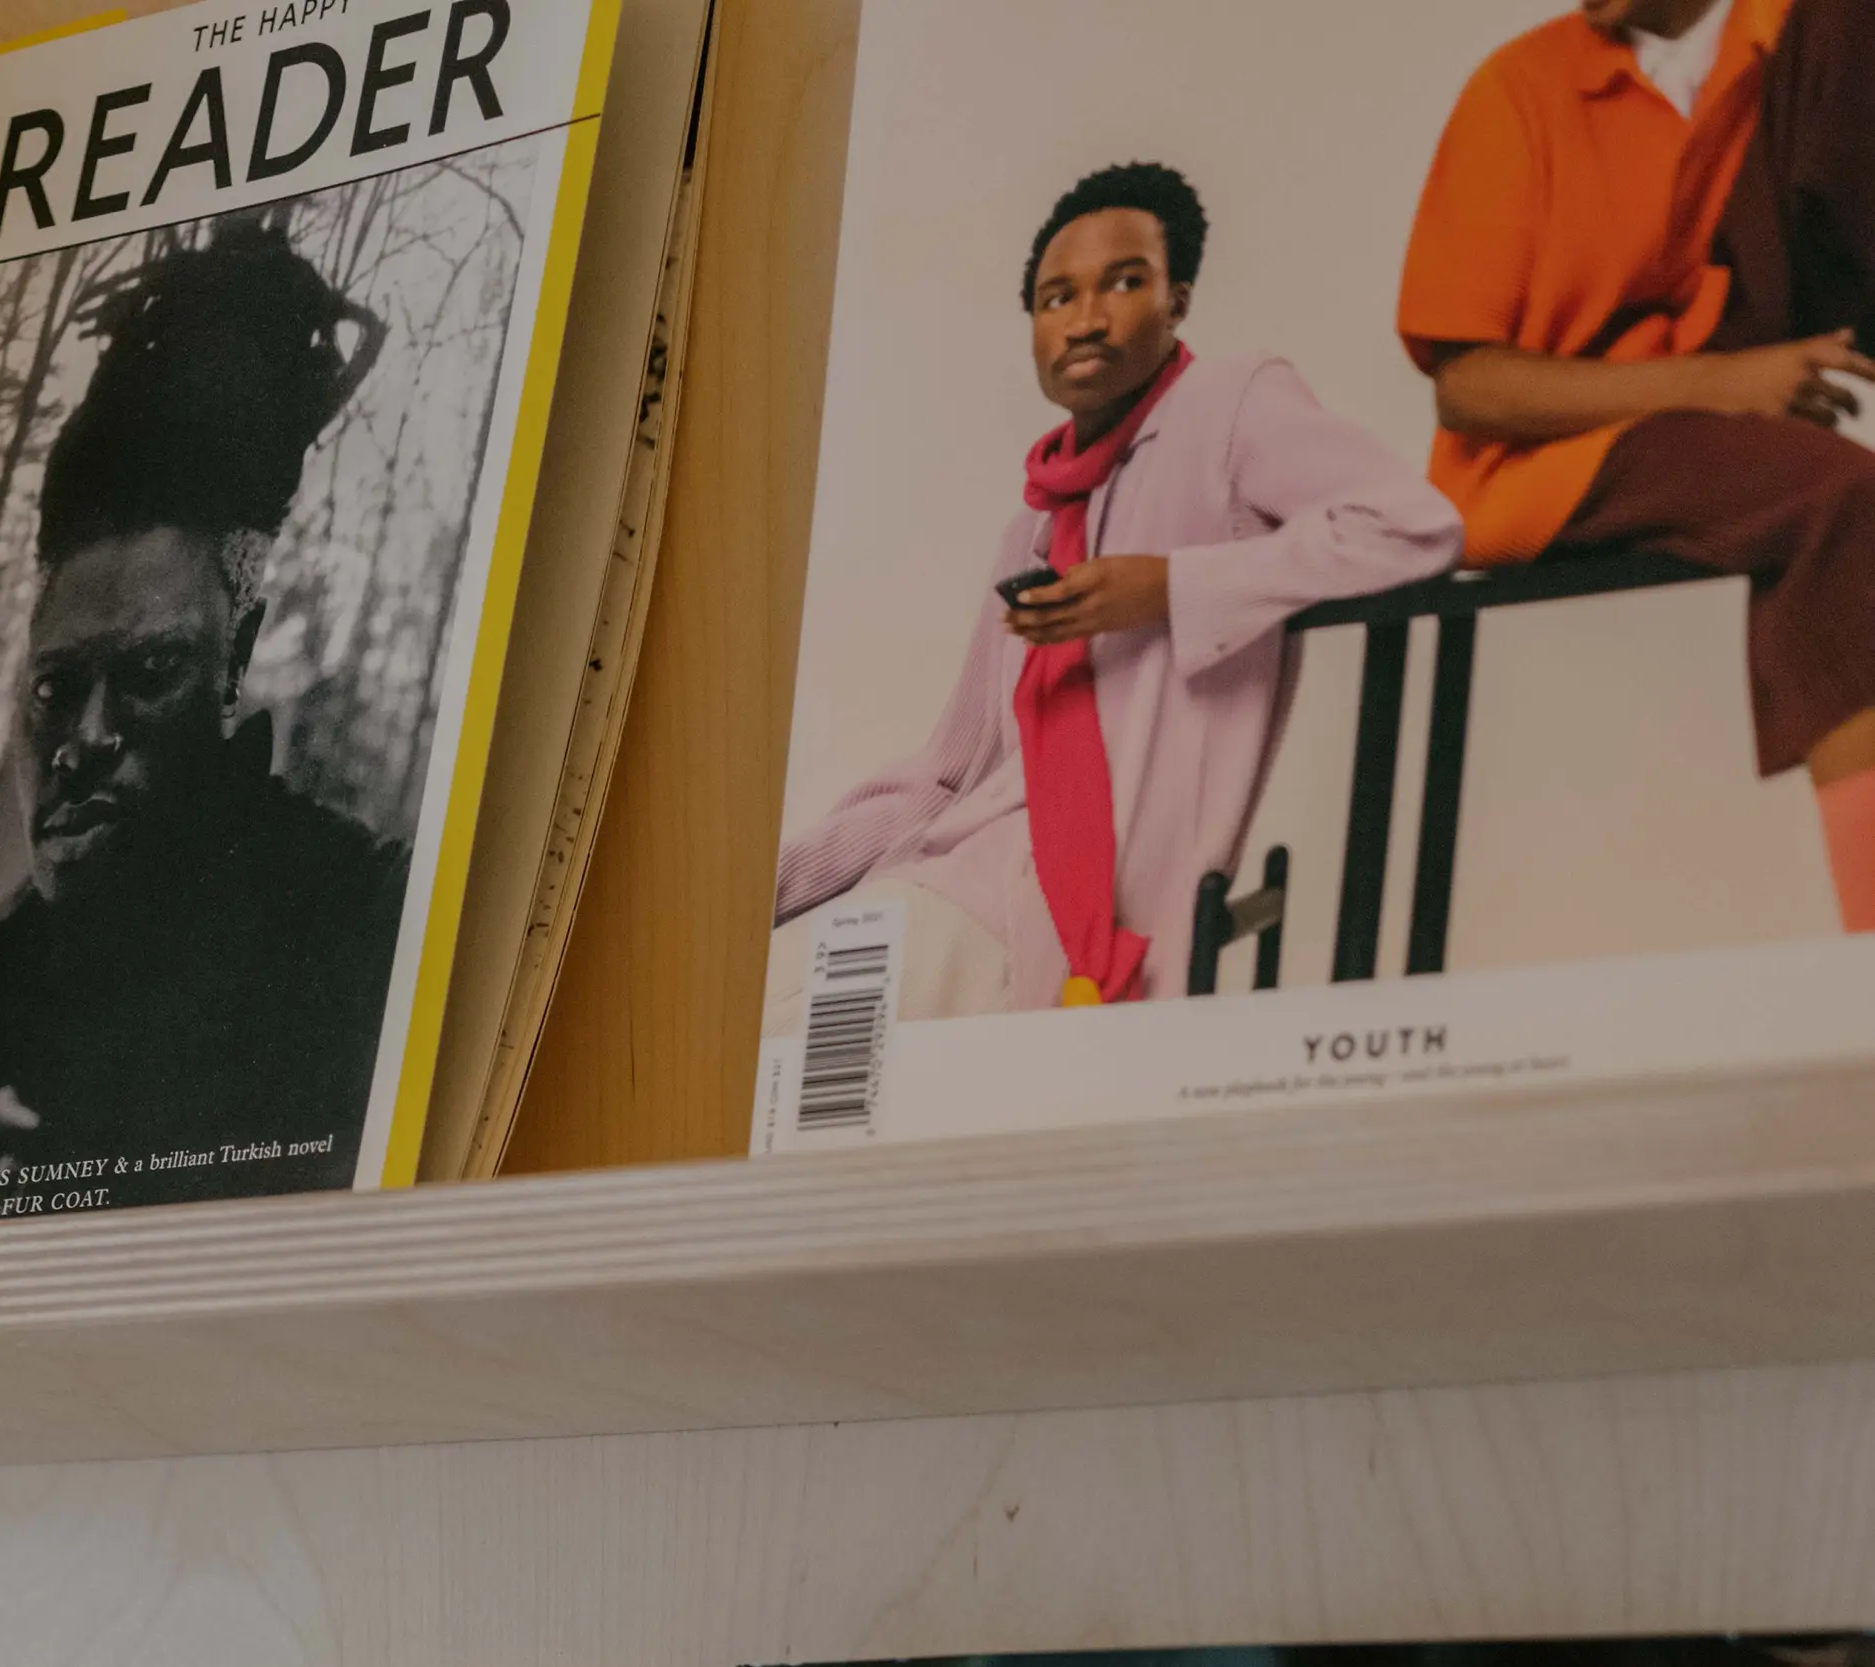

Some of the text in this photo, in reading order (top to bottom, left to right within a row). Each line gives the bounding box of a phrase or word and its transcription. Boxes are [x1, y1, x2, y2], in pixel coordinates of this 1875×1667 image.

[192, 15, 247, 52] THE
[1302, 1024, 1449, 1065] YOUTH
[17, 1157, 111, 1185] SUMNEY
[113, 1156, 129, 1176] &
[134, 1160, 144, 1174] a
[149, 1150, 215, 1172] brilliant
[219, 1138, 282, 1164] Turkish
[285, 1133, 335, 1155] novel
[2, 1194, 44, 1217] FUR
[49, 1187, 113, 1212] COAT.
